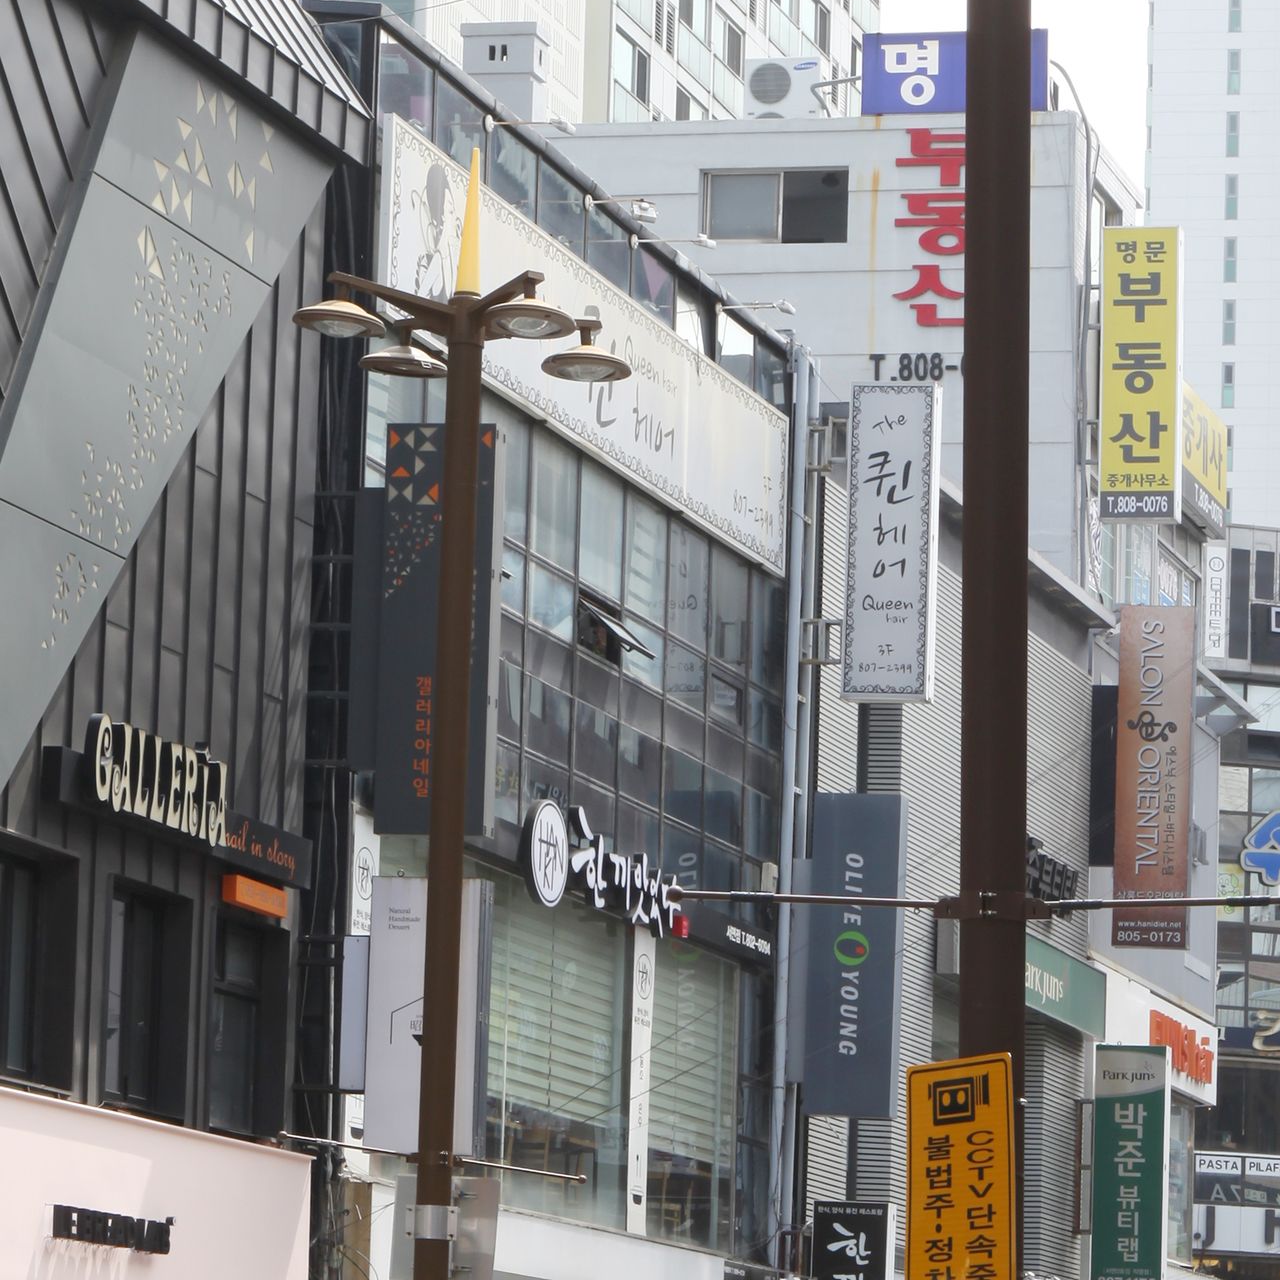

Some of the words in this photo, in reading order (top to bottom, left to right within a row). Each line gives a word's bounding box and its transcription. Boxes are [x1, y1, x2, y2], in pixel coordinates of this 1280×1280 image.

[1115, 241, 1167, 264] 명문
[870, 353, 966, 382] T.808-
[1109, 272, 1168, 464] 부동산
[872, 413, 907, 437] The
[1107, 473, 1170, 488] 중개사무소
[1107, 494, 1168, 514] T.808-0076
[862, 595, 914, 613] Queen
[878, 644, 895, 656] 3F
[858, 663, 912, 674] 807-2399
[1139, 619, 1166, 707] SALON
[94, 713, 228, 848] GALLERIA
[1135, 745, 1162, 877] ORIENTAL
[252, 837, 263, 858] in
[266, 839, 297, 881] story
[1117, 931, 1181, 943] 805-0173
[838, 970, 860, 1057] YOUNG
[1103, 1070, 1129, 1081] Park
[1199, 1158, 1239, 1172] PASTA
